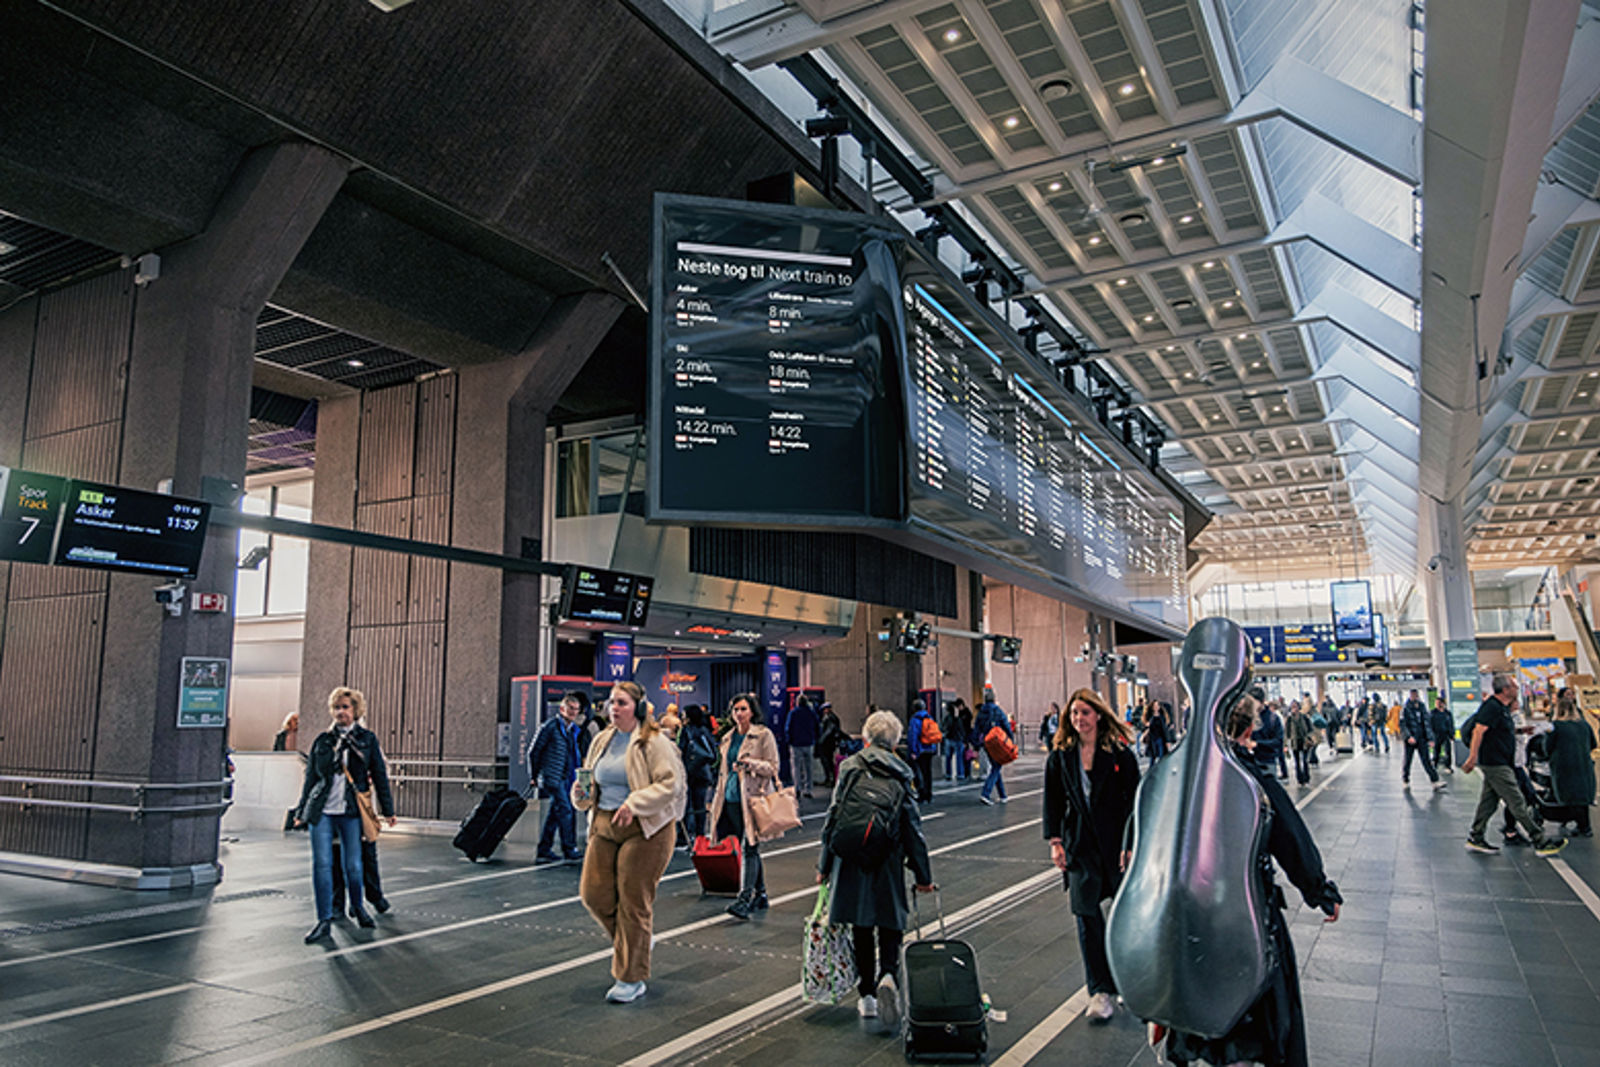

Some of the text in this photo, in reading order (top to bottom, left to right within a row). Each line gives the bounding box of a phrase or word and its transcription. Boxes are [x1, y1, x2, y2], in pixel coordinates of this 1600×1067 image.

[677, 257, 853, 286] Neste tog til Next train to
[676, 299, 713, 313] 4 min.
[769, 306, 803, 319] 8 min.
[676, 358, 713, 373] 2 min.
[769, 365, 811, 380] 18 min.
[20, 484, 48, 499] Spor
[18, 496, 48, 510] Track
[76, 503, 114, 518] Asker
[18, 516, 40, 545] 7
[167, 516, 199, 531] 11:57
[634, 600, 644, 619] 8
